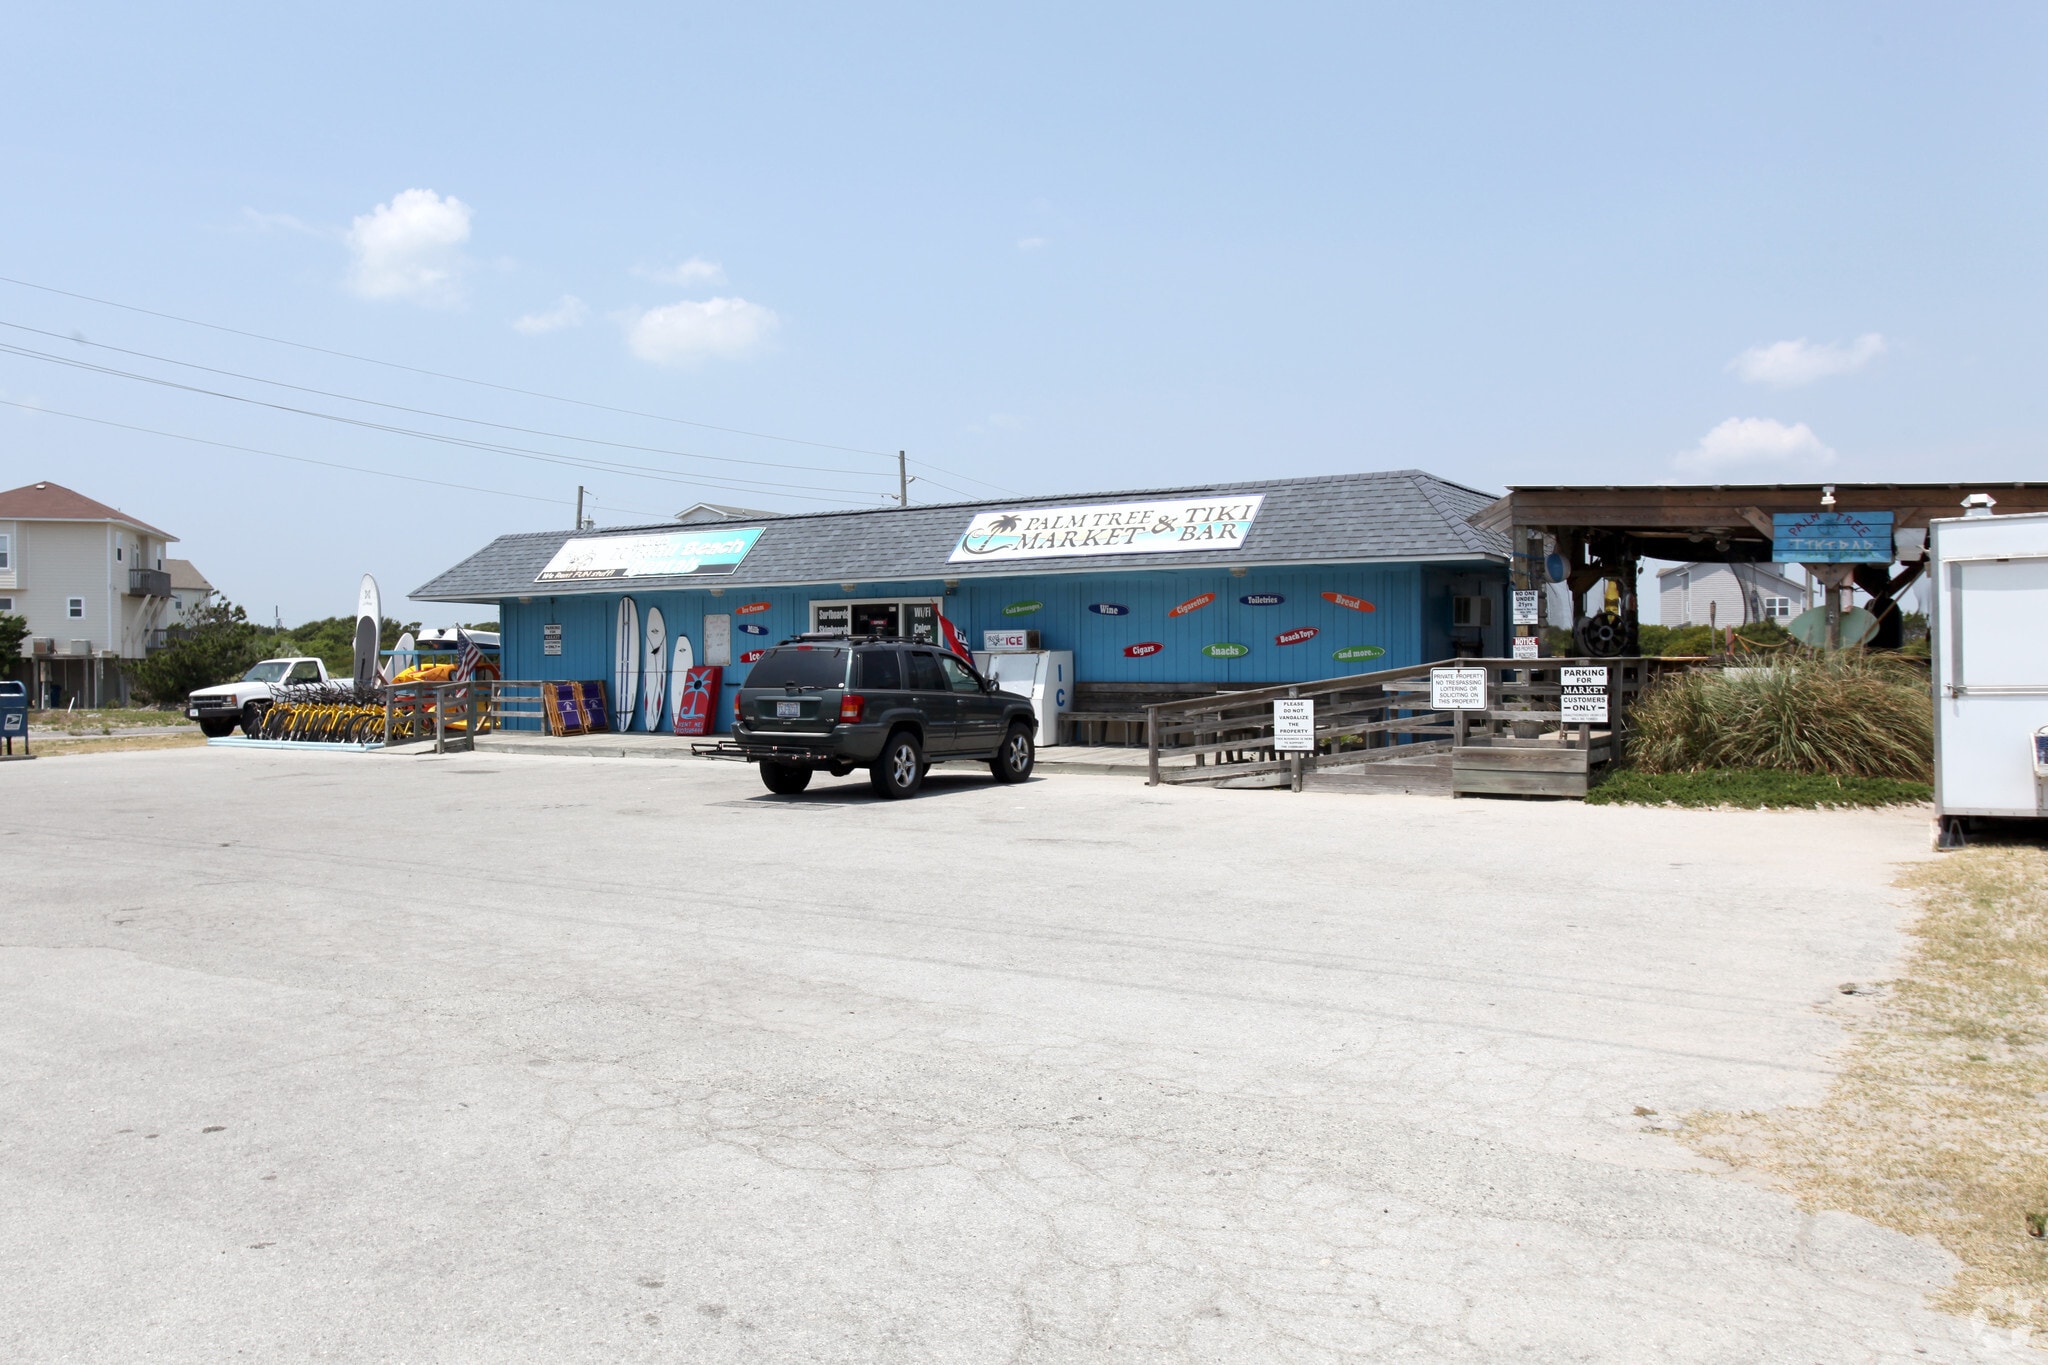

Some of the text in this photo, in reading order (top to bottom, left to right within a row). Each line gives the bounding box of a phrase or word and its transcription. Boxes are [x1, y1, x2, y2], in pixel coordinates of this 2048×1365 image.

[1184, 504, 1254, 523] TIKI
[1024, 510, 1155, 531] PALM TREE
[1151, 515, 1178, 534] &
[1788, 511, 1872, 538] PALM TREE
[1013, 526, 1146, 550] MARKET
[1178, 523, 1239, 541] BAR
[680, 538, 744, 555] Beach
[1791, 539, 1874, 557] TIKI BAR
[541, 572, 554, 580] We
[554, 571, 573, 579] Rent
[572, 570, 592, 578] FUN
[1176, 595, 1209, 614] Cigarettes
[1247, 596, 1278, 604] Toiletries
[1335, 594, 1360, 609] Bread
[749, 604, 765, 613] Cream
[818, 609, 849, 620] Surfboards
[914, 606, 931, 618] Wi/Fi
[1005, 603, 1040, 615] Cold Beverages
[1100, 604, 1118, 615] Wine
[746, 625, 760, 634] Milk
[1005, 636, 1023, 646] ICE
[1280, 630, 1314, 644] Beach Toys
[1132, 644, 1155, 655] Cigars
[1211, 646, 1239, 656] Snacks
[1338, 651, 1352, 659] and
[748, 651, 760, 662] Ice
[1056, 664, 1065, 706] IC
[1563, 686, 1605, 694] MARKET
